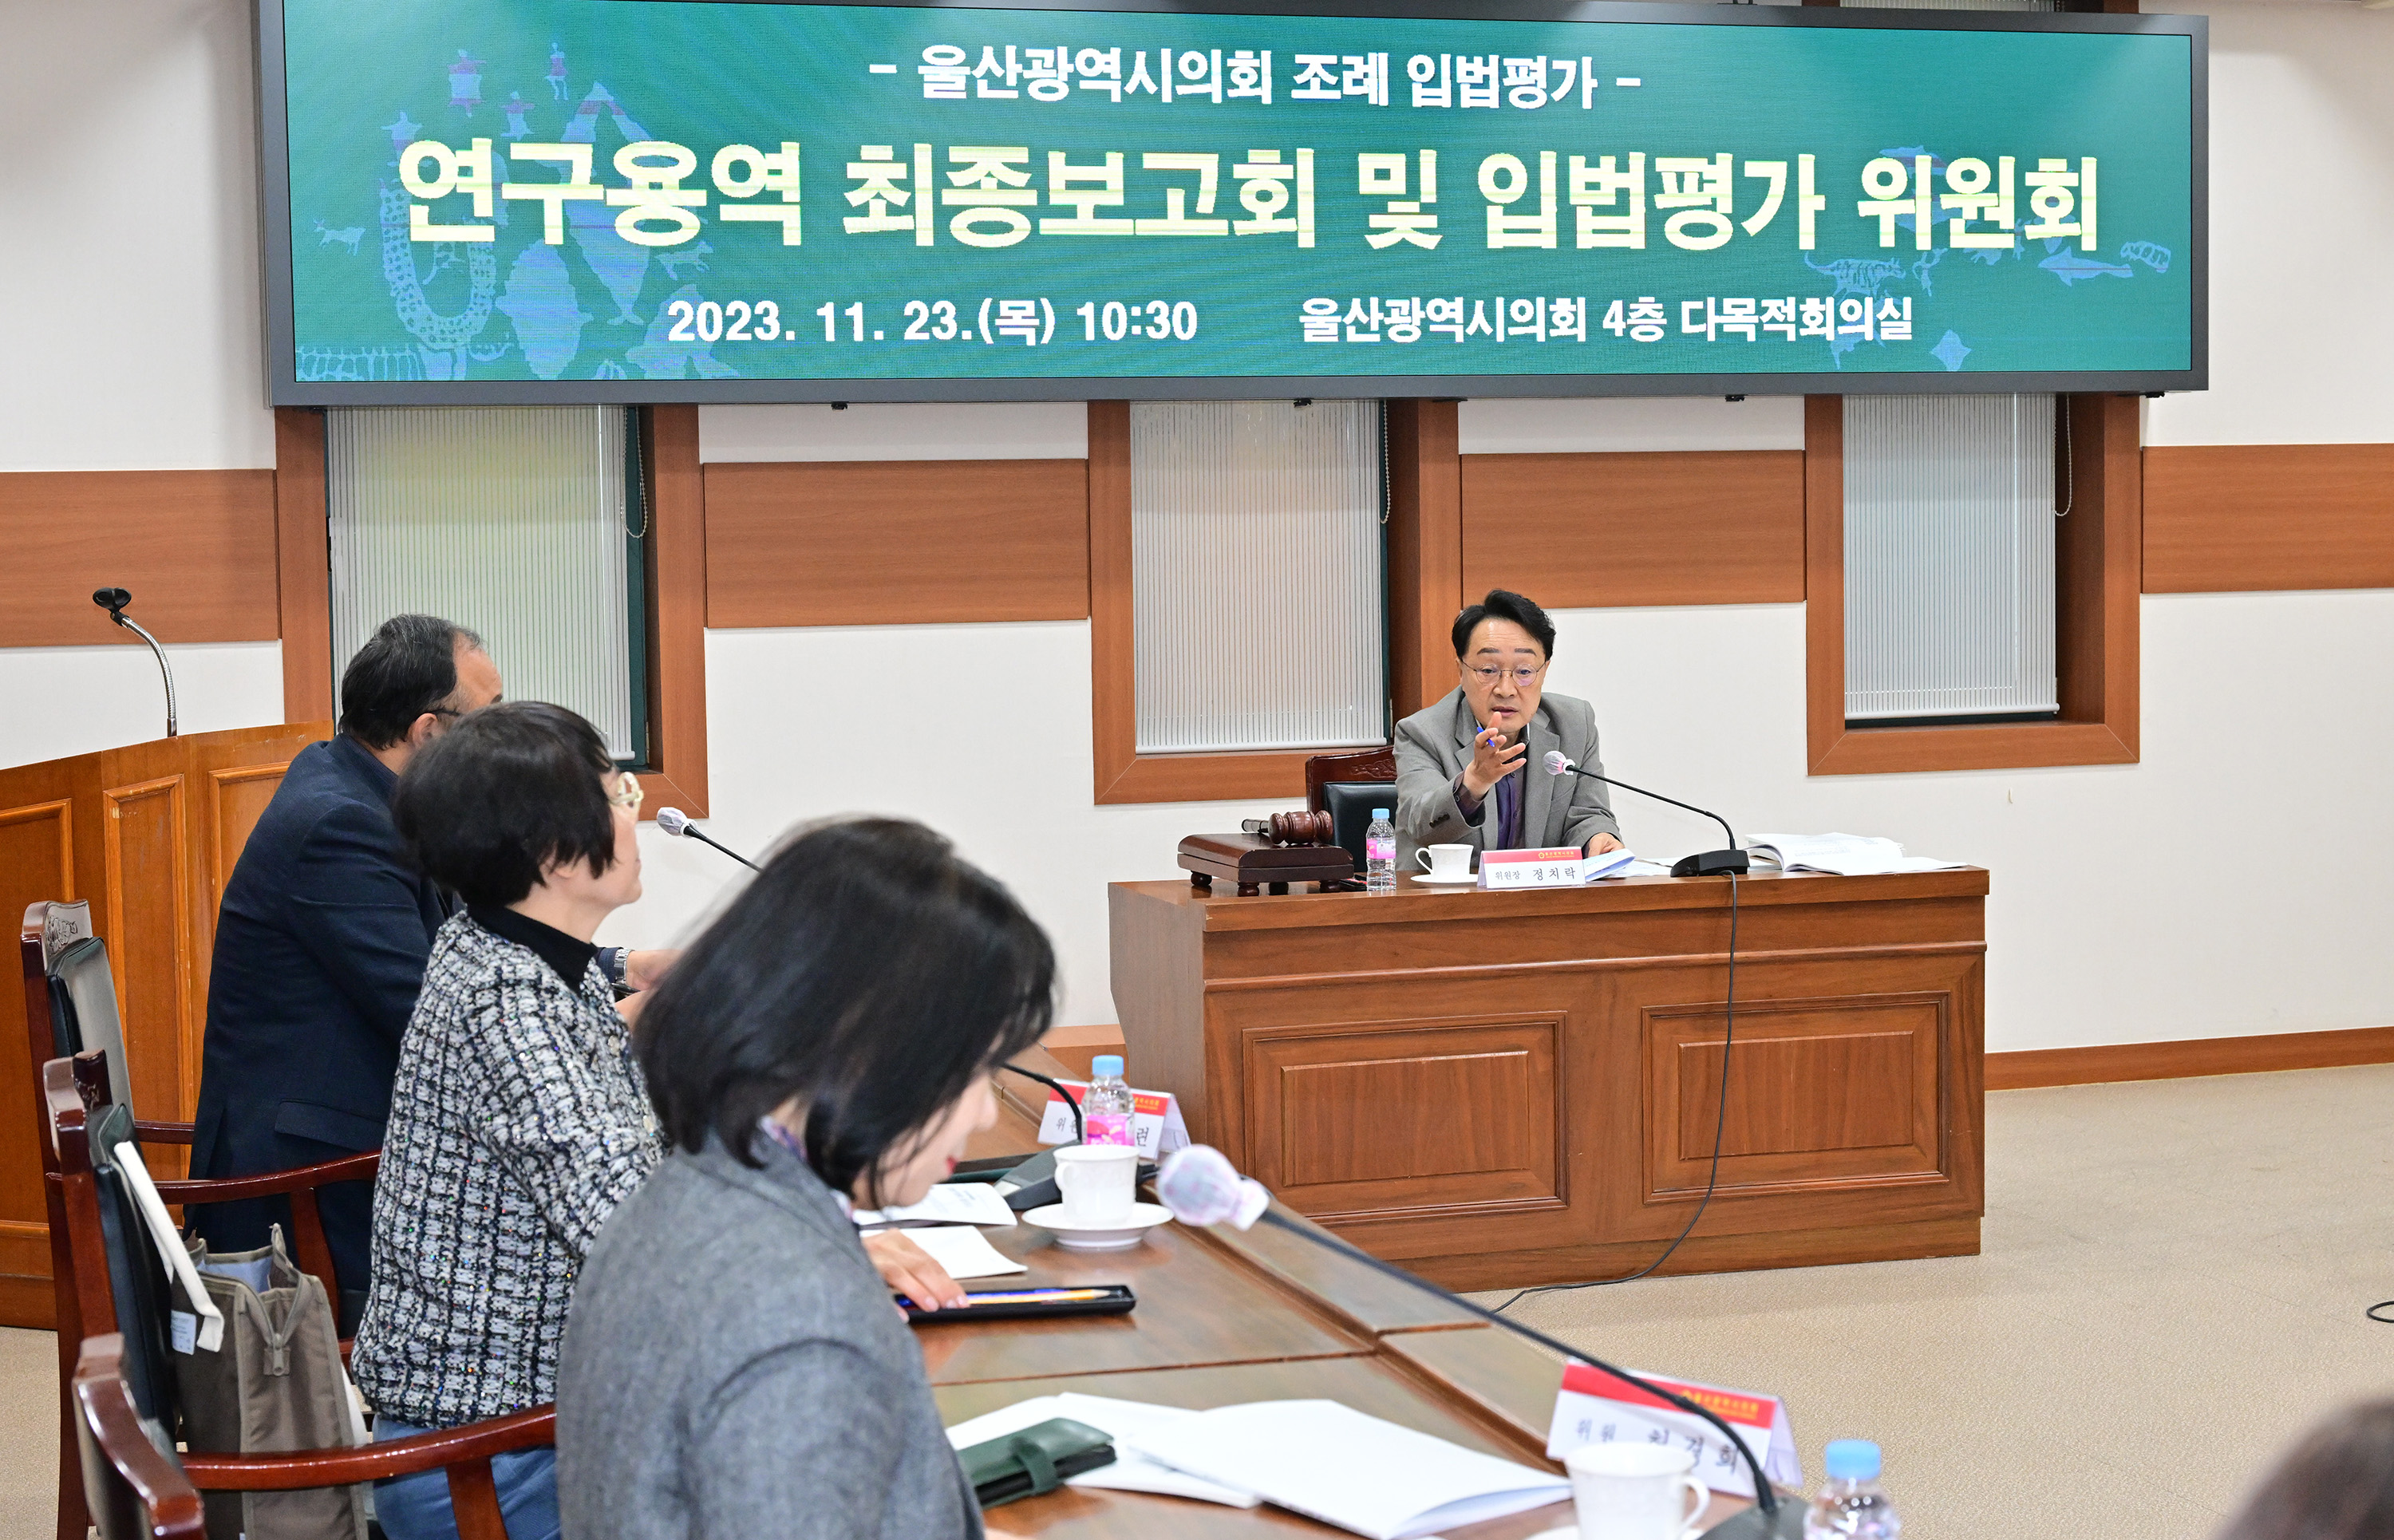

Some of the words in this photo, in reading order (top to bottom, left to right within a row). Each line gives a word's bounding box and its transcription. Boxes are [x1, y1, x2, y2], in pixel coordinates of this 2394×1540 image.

[918, 45, 1272, 105] 울산광역시의회
[1291, 53, 1389, 105] 조례
[1407, 54, 1598, 109] 입법평가
[399, 138, 801, 247] 연구용역
[843, 144, 1315, 248] 최종보고회
[1358, 150, 1443, 250] 및
[1478, 152, 1826, 251] 입법평가
[1857, 156, 2099, 251] 위원회
[668, 301, 796, 342] 2023.
[817, 302, 885, 342] 11.
[903, 298, 1055, 346] 23.(목)
[1077, 301, 1198, 341] 10:30
[1299, 297, 1586, 343] 울산광역시의회
[1602, 297, 1667, 342] 4층
[1681, 298, 1913, 342] 다목적회의실
[1495, 871, 1521, 881] 위원장
[1532, 867, 1576, 881] 정치락
